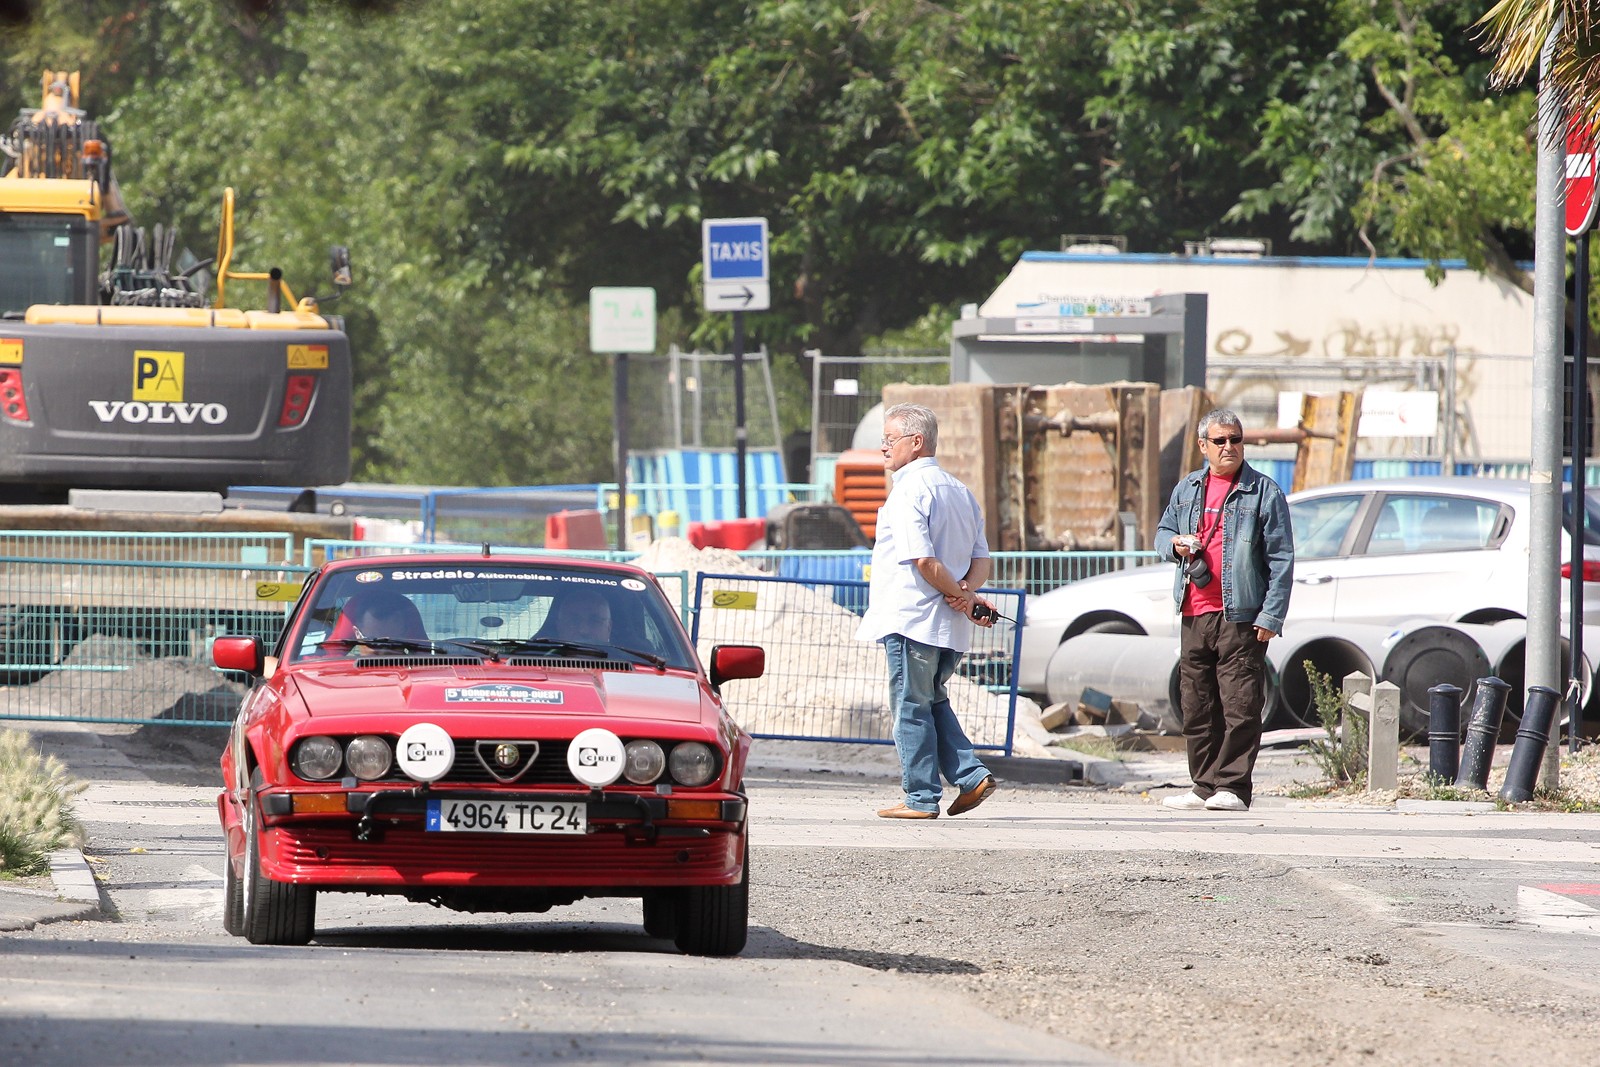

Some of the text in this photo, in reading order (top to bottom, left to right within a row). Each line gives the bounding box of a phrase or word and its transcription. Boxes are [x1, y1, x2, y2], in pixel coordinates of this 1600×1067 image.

[711, 241, 762, 261] TAXIS
[137, 357, 180, 391] PA
[88, 400, 228, 424] VOLVO
[391, 570, 475, 580] Stradale
[477, 572, 552, 580] Automobiles
[561, 576, 617, 586] MERIGNAC
[461, 689, 509, 697] BORDEAUX
[431, 818, 436, 826] F
[447, 803, 580, 830] 4964 TC 24
